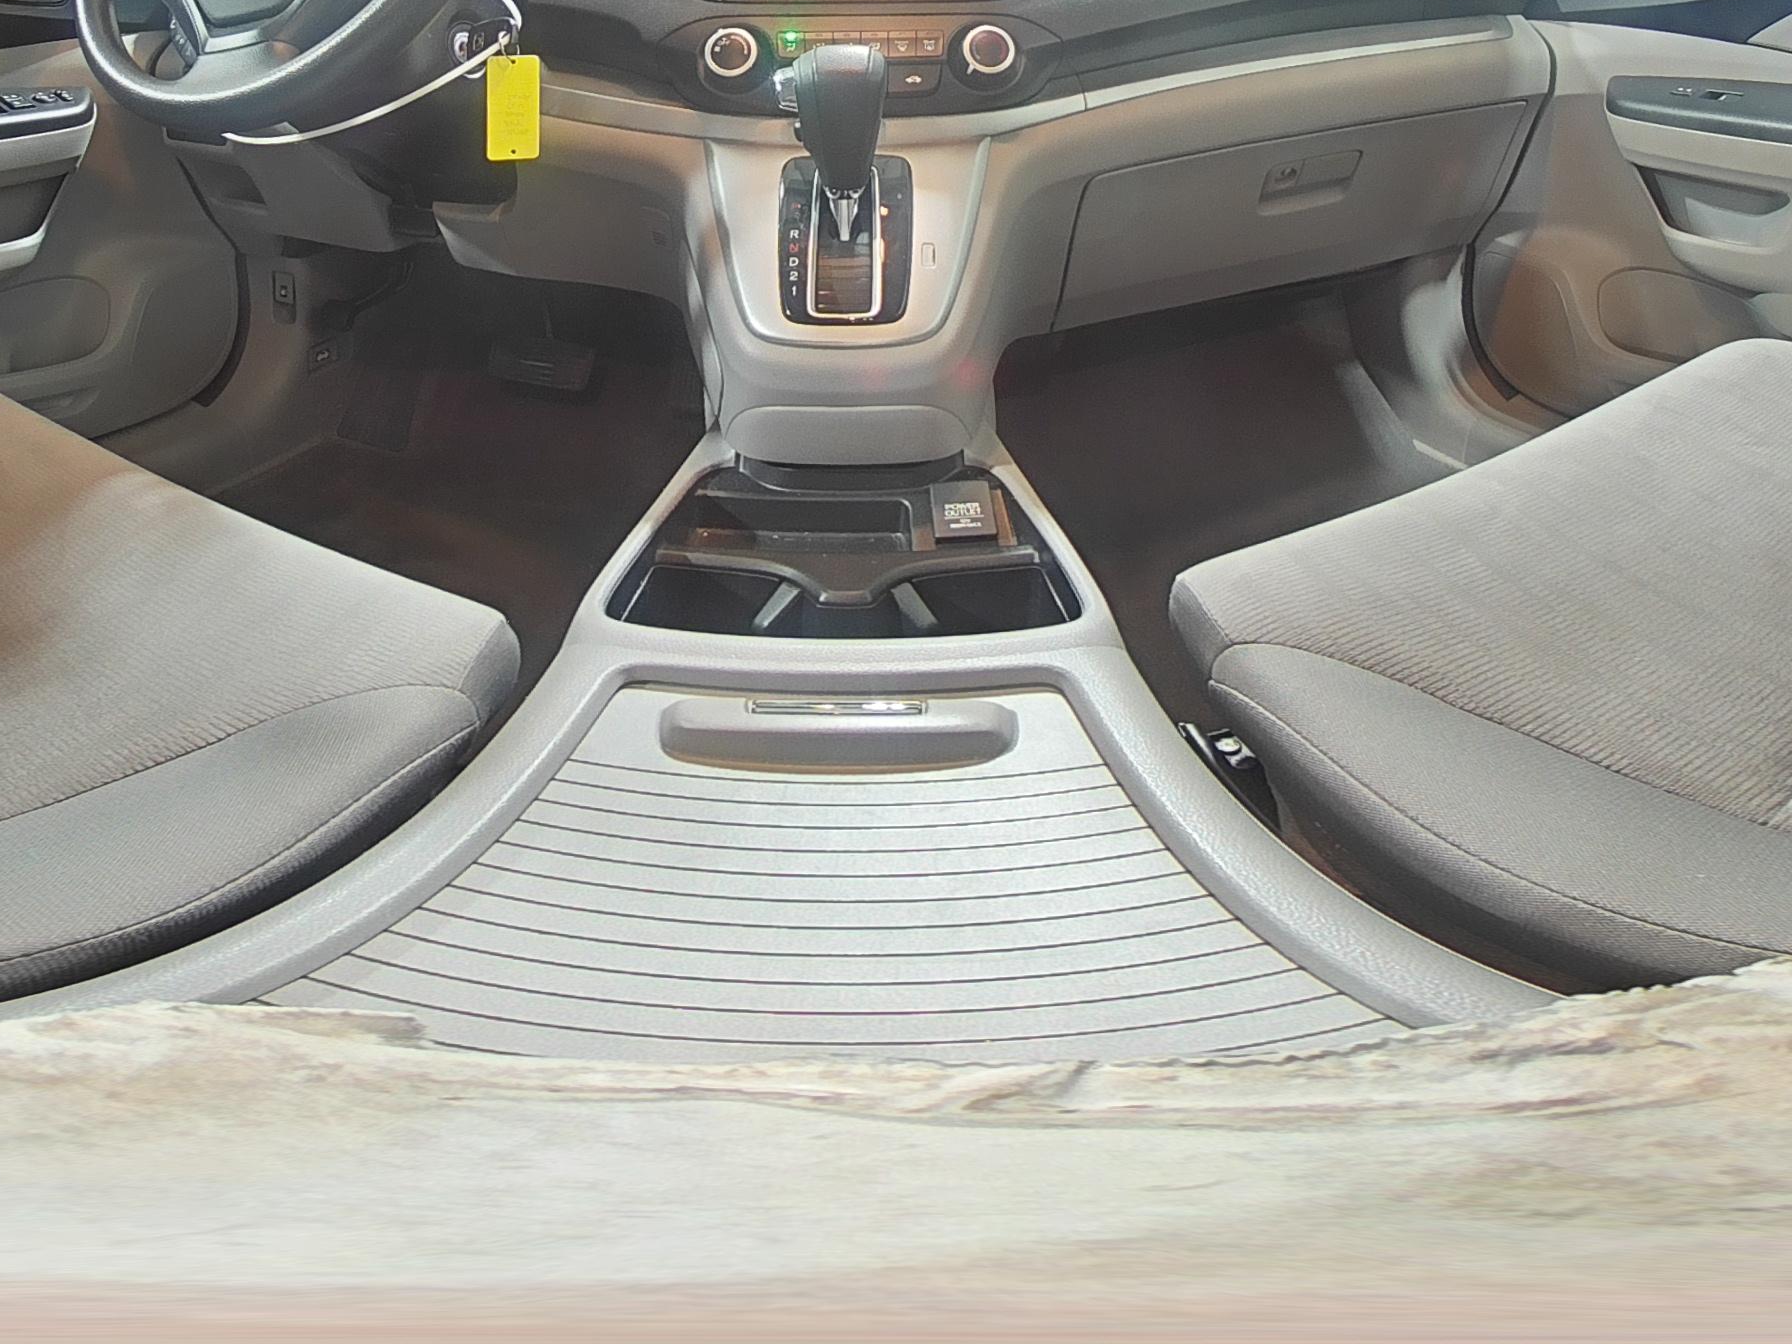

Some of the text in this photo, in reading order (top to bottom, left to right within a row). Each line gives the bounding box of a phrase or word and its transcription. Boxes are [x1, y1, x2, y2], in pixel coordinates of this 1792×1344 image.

[789, 229, 799, 239] R
[789, 243, 799, 253] N
[789, 256, 799, 267] D
[789, 271, 799, 281] 2
[791, 285, 797, 296] 1
